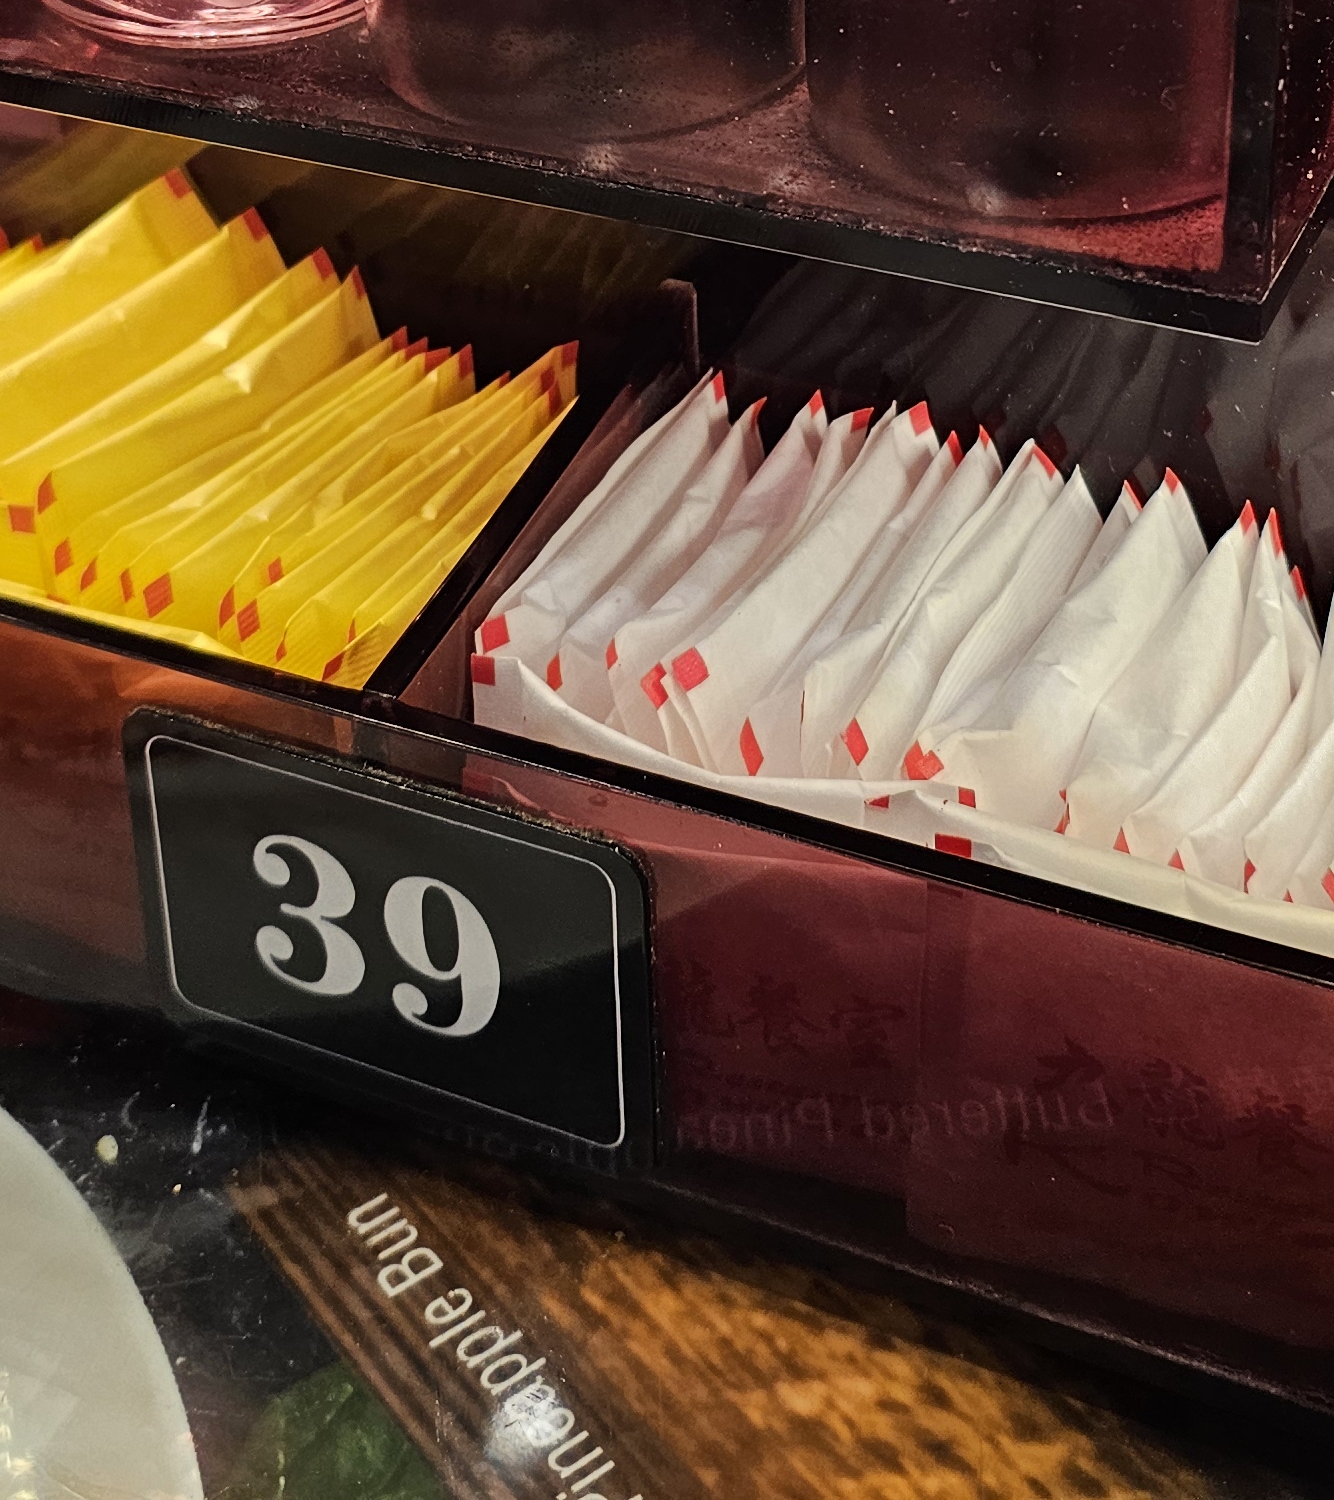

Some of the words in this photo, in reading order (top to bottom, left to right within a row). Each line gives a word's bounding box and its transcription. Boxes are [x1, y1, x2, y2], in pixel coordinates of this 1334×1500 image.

[253, 834, 501, 1038] 39
[347, 1192, 444, 1299] Bun
[426, 1286, 643, 1500] ineapple
